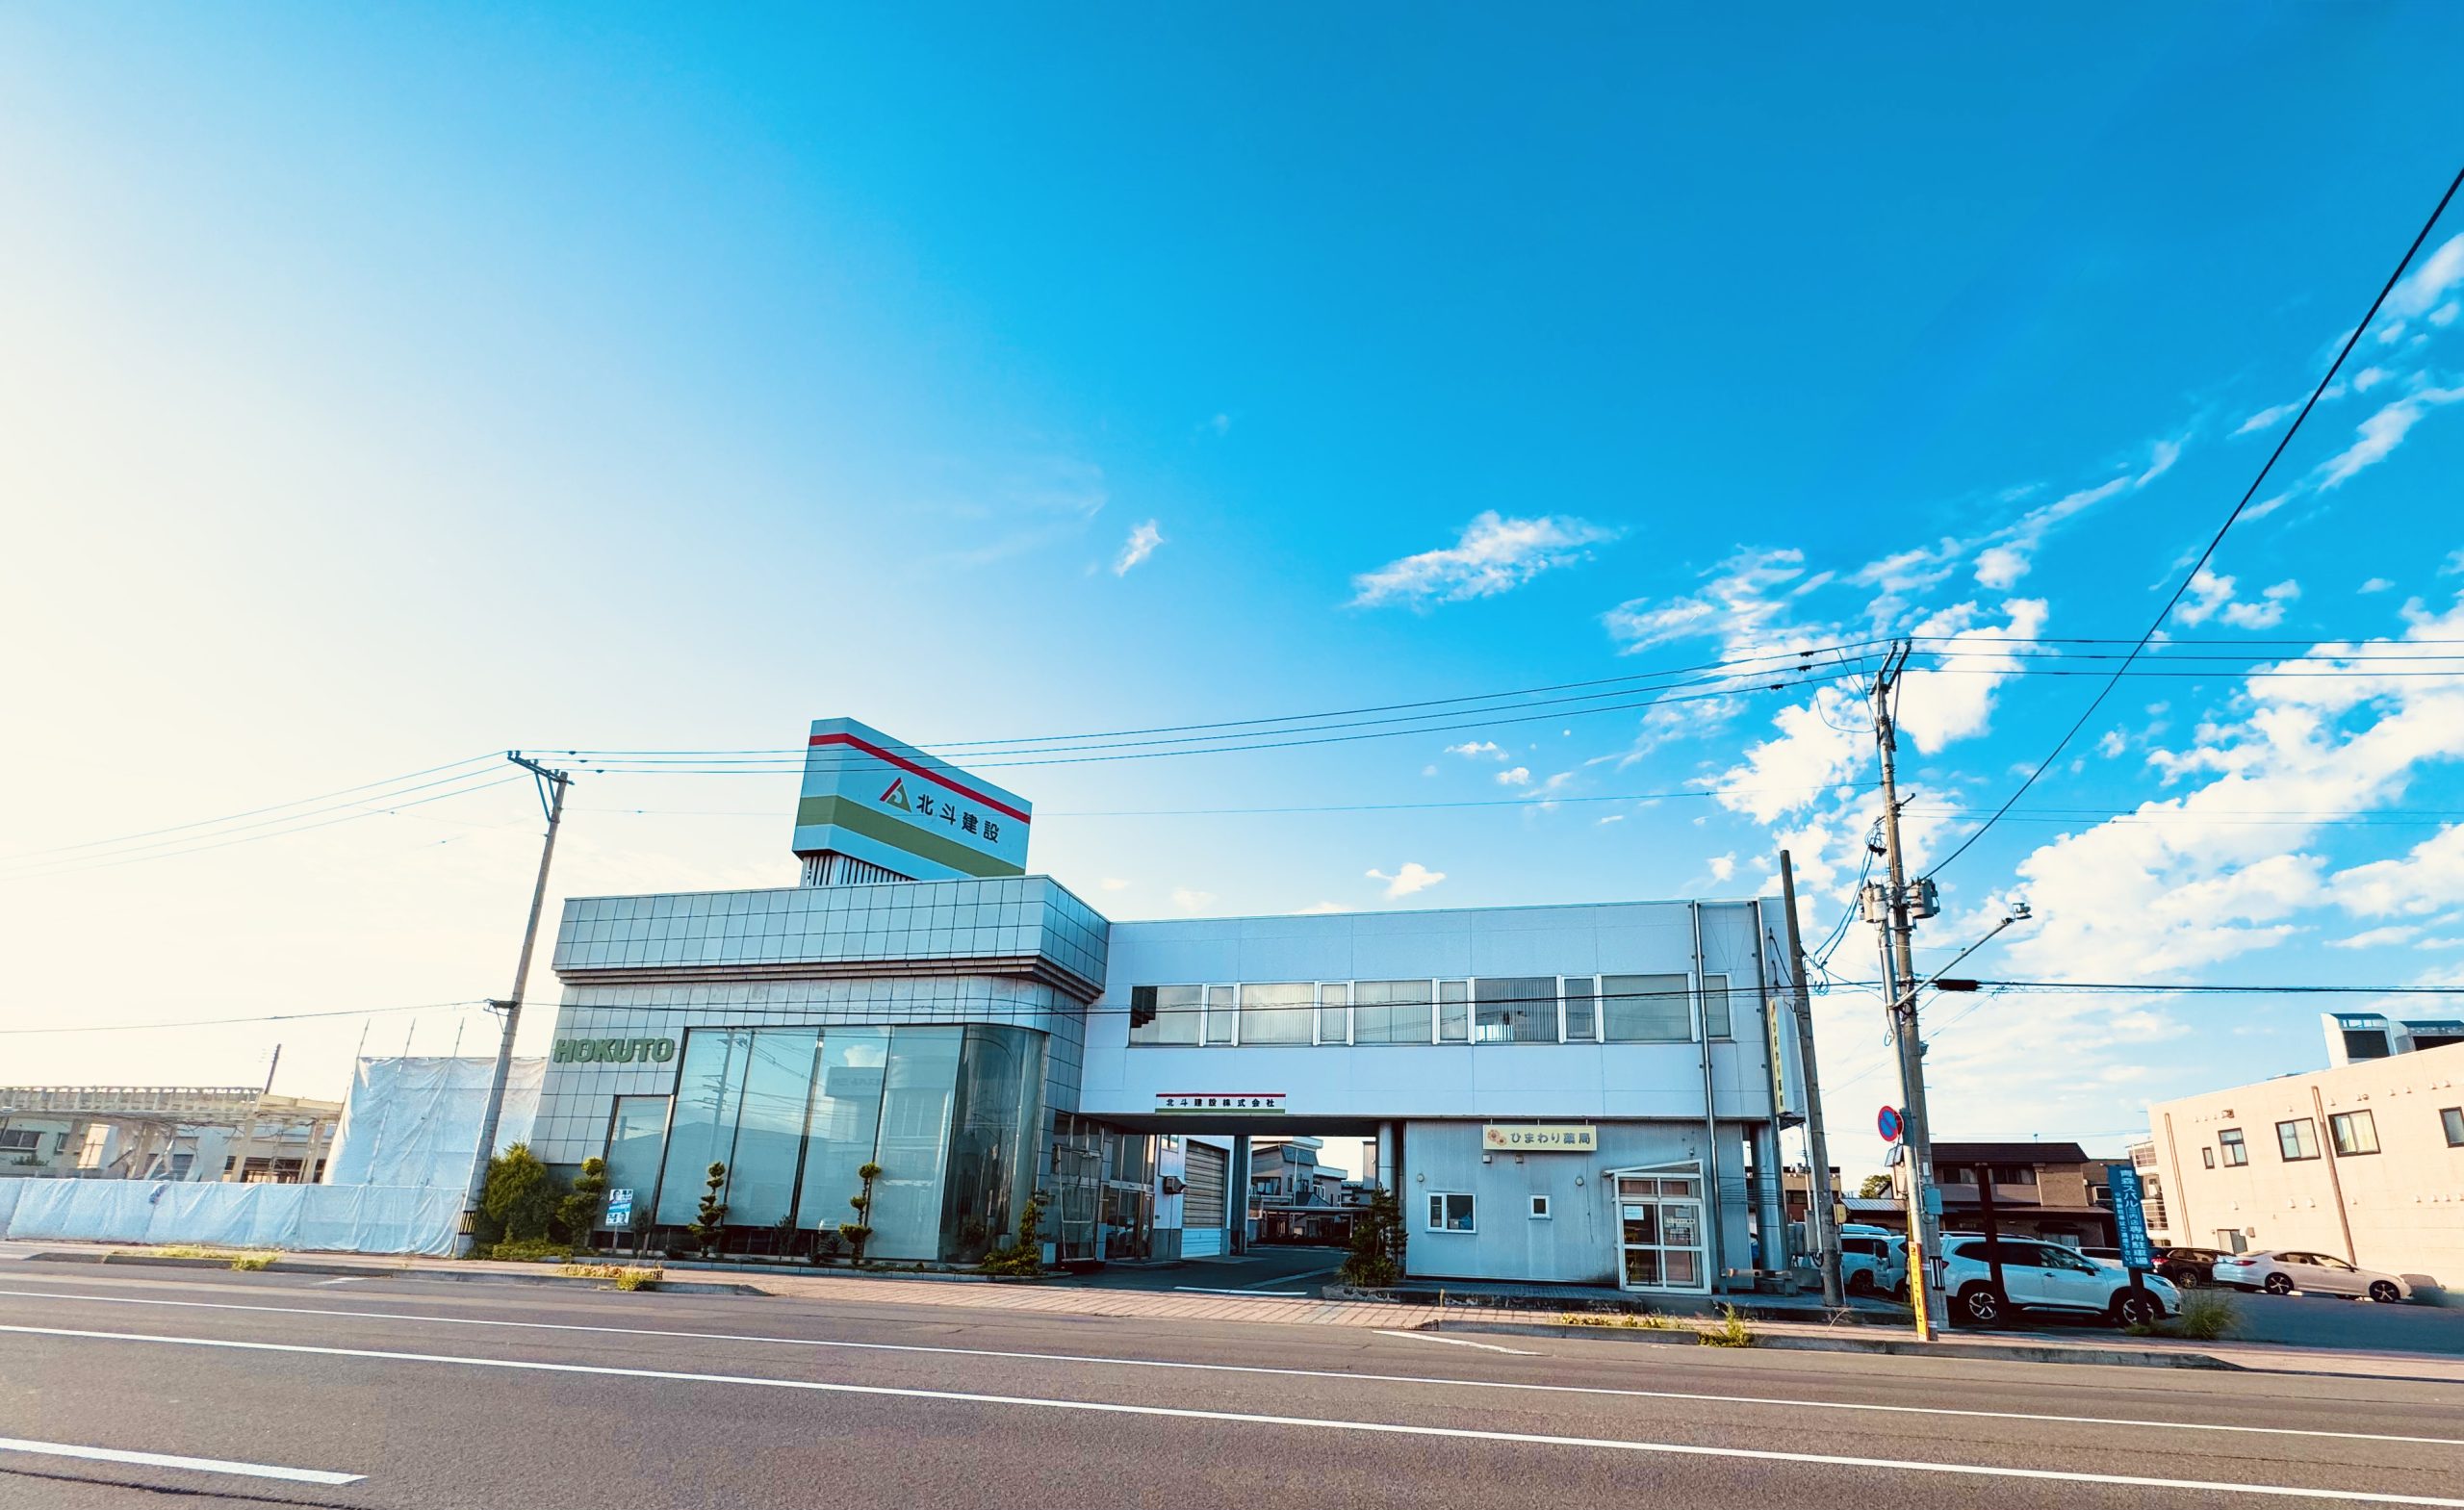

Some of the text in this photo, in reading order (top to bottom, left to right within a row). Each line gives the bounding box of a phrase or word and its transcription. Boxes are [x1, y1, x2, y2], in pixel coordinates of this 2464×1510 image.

[915, 793, 1000, 844] 北斗建設
[552, 1037, 676, 1063] HOKUTO
[1772, 1022, 1784, 1106] ひまわり
[1166, 1097, 1275, 1109] 北斗建設株式会社
[1509, 1131, 1591, 1145] ひまわり薬局
